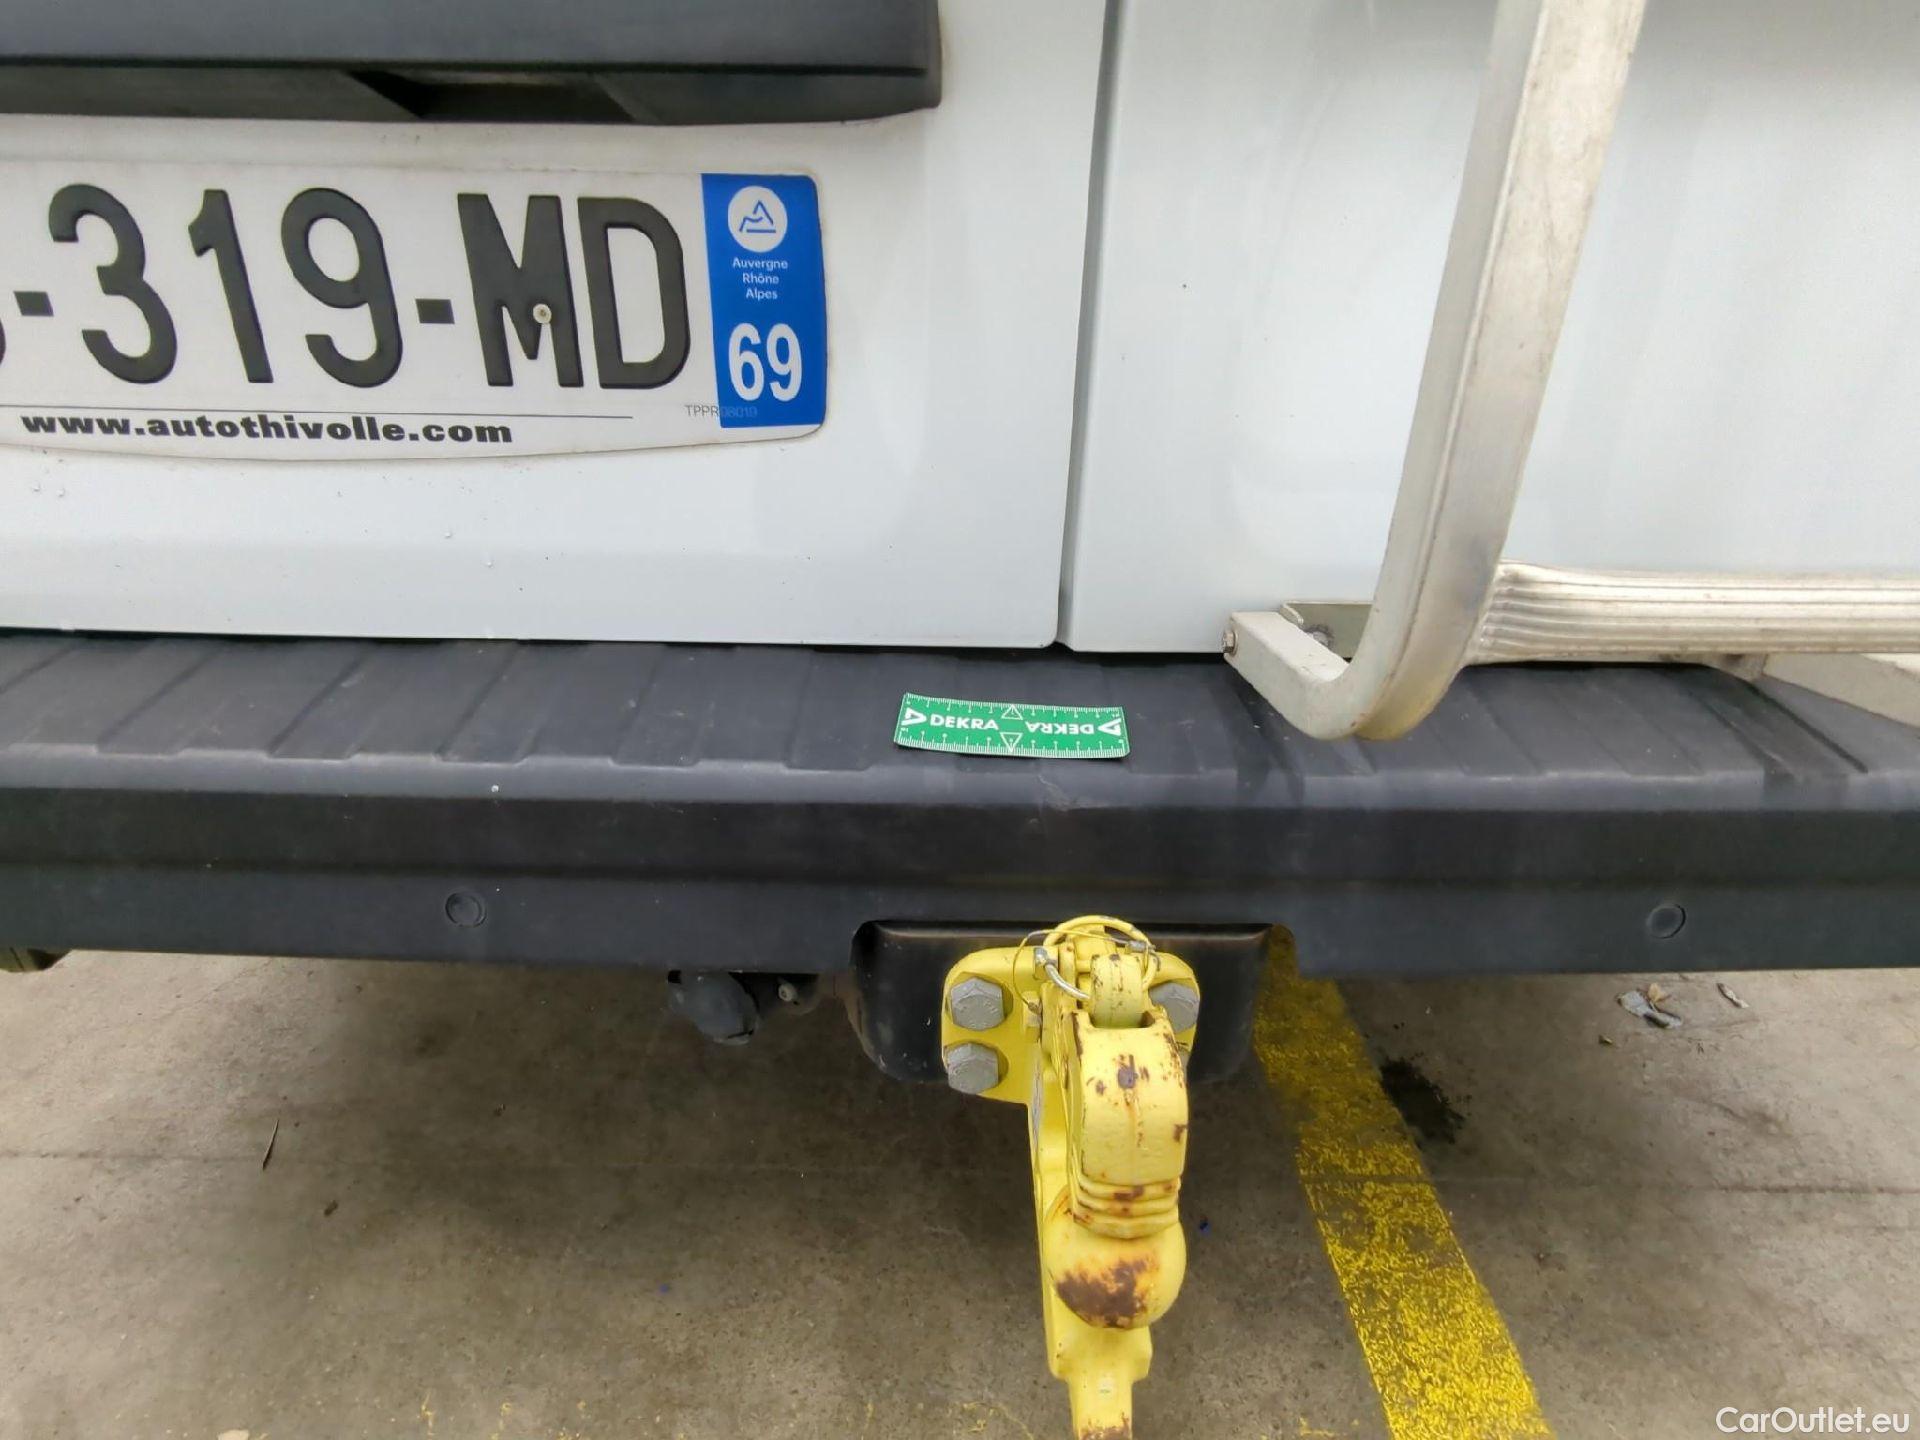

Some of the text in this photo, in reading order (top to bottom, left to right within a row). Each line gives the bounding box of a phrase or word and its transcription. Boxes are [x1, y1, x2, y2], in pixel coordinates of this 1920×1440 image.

[732, 256, 788, 271] Auvergne
[742, 272, 780, 284] Rhône
[0, 183, 691, 390] -319-MD
[745, 287, 778, 301] Alpes
[728, 323, 802, 401] 69
[21, 414, 513, 443] www.autothivolle.com
[929, 713, 999, 730] DEKRA
[1025, 720, 1095, 735] DEKRA
